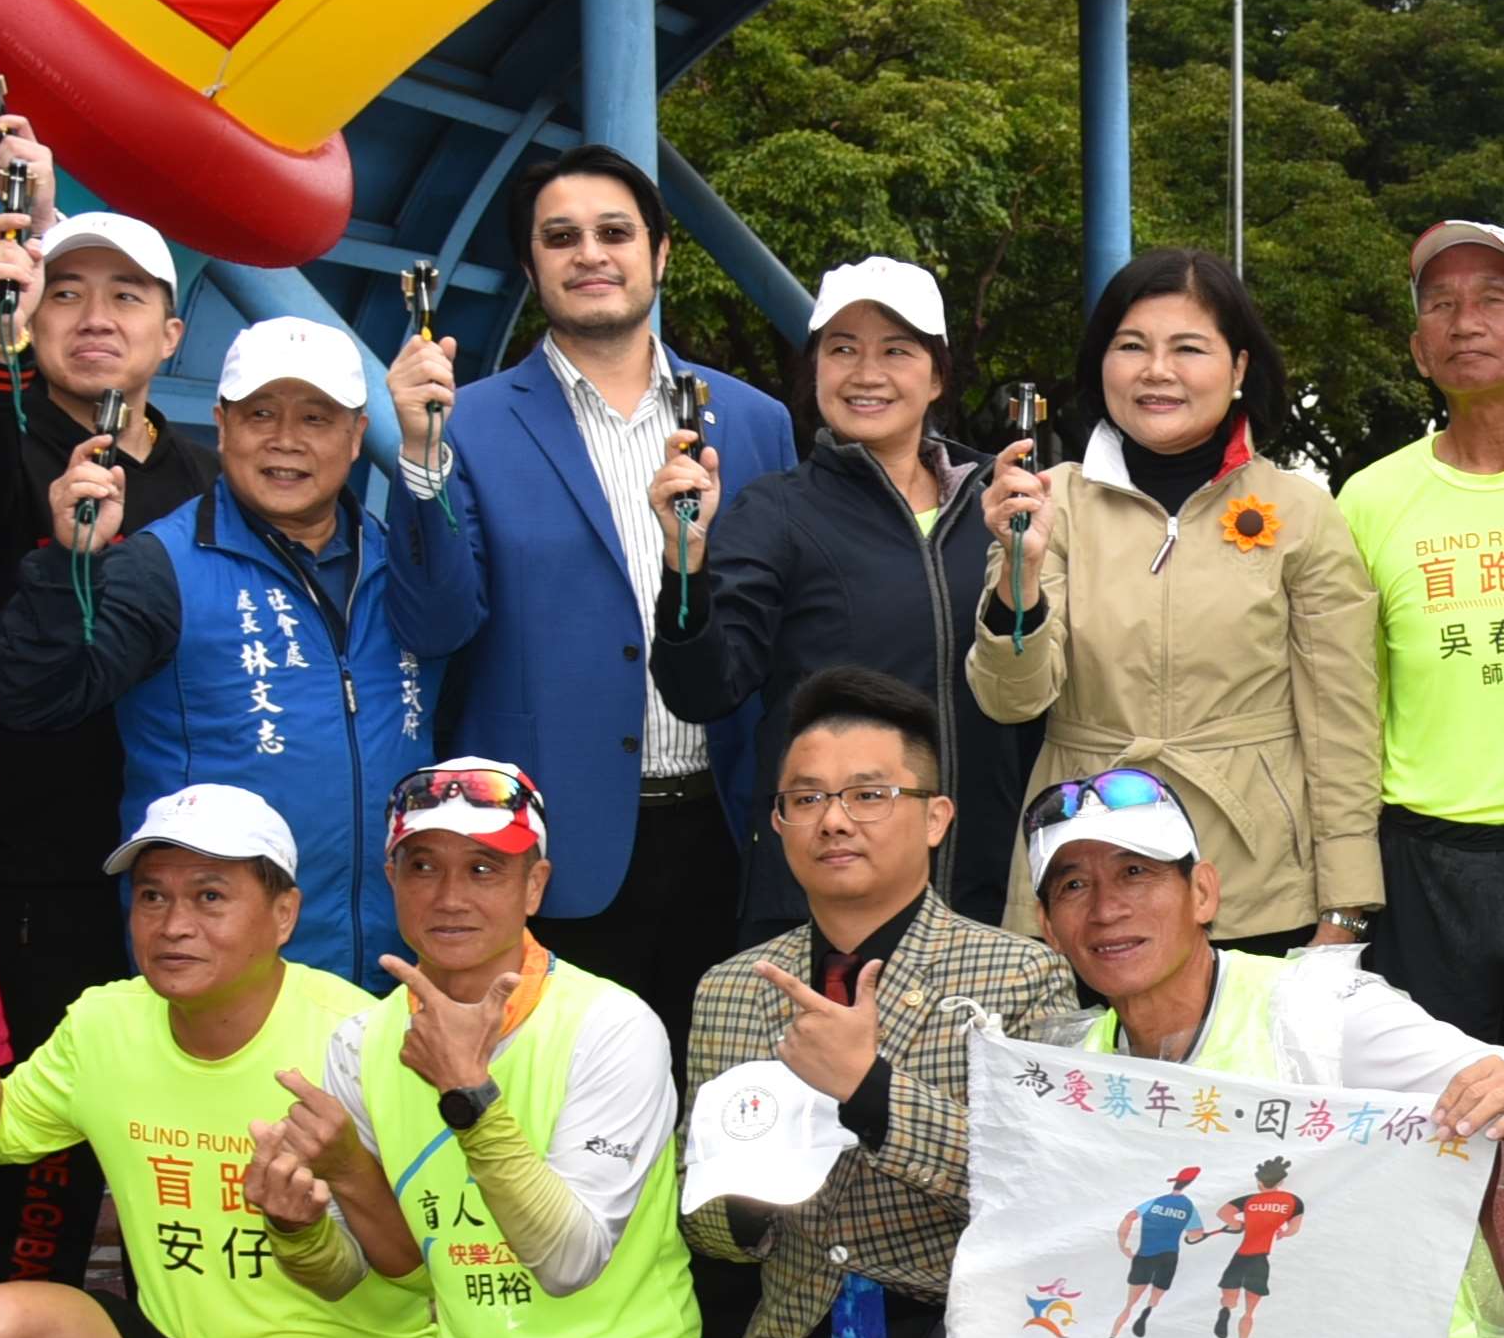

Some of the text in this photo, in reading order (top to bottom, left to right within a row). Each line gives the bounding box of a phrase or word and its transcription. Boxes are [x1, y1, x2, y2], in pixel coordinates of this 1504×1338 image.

[1415, 532, 1480, 557] BLIND
[240, 640, 285, 754] 林文志
[129, 1122, 190, 1149] BLIND
[418, 1190, 485, 1230] 盲人
[1150, 1202, 1186, 1222] BLIND
[1248, 1202, 1290, 1216] GUIDE
[157, 1221, 273, 1280] 安仔
[465, 1272, 532, 1307] 明裕
